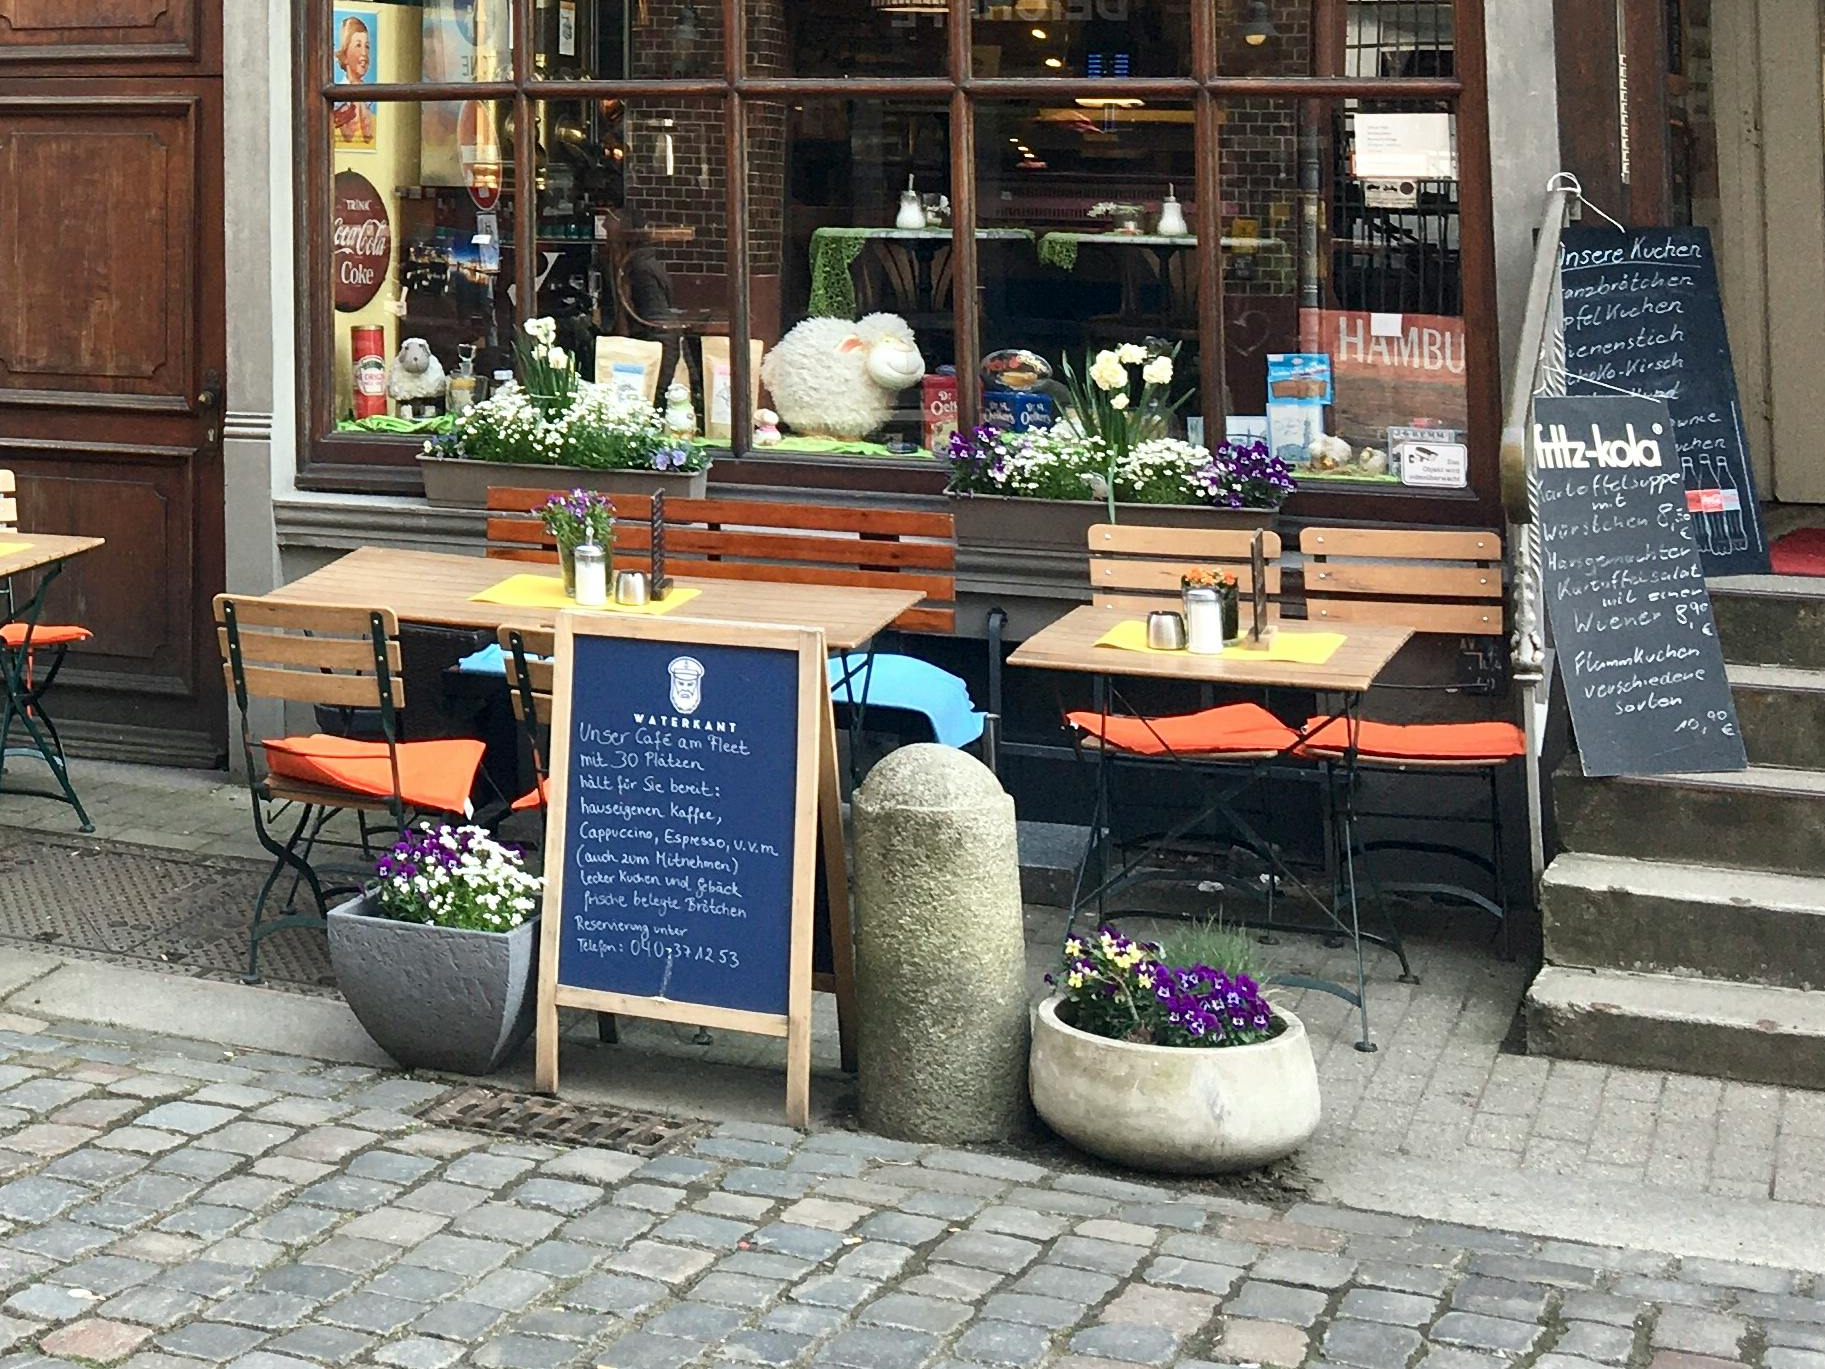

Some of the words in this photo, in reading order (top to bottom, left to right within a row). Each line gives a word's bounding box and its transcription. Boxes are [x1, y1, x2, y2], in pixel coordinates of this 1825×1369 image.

[345, 199, 372, 211] TRINK
[1630, 235, 1703, 260] Kuchen
[341, 260, 374, 286] Coke
[1565, 323, 1685, 359] ienenstich
[1574, 609, 1662, 634] Wiener
[1584, 668, 1706, 699] verschiedene
[633, 712, 738, 733] WATERKANT
[579, 722, 631, 746] Unser
[635, 727, 673, 750] Café
[678, 736, 703, 749] am
[707, 734, 751, 756] Fleet
[580, 752, 609, 768] mit
[610, 751, 639, 768] 30
[644, 752, 705, 771] Plätzen
[580, 774, 614, 791] hält
[617, 778, 636, 795] für
[642, 776, 665, 793] Sie
[580, 796, 665, 821] hauseigenen
[579, 821, 659, 845] Cappuccino,
[576, 844, 619, 867] (auch
[621, 852, 650, 866] zum
[656, 850, 739, 876] Mitnehmen)
[619, 870, 661, 887] Kuchen
[665, 875, 692, 892] und
[584, 890, 628, 912] frische
[633, 890, 681, 917] belegte
[684, 896, 747, 919] Brötchen
[574, 915, 650, 940] Reservierung
[653, 925, 689, 937] unter
